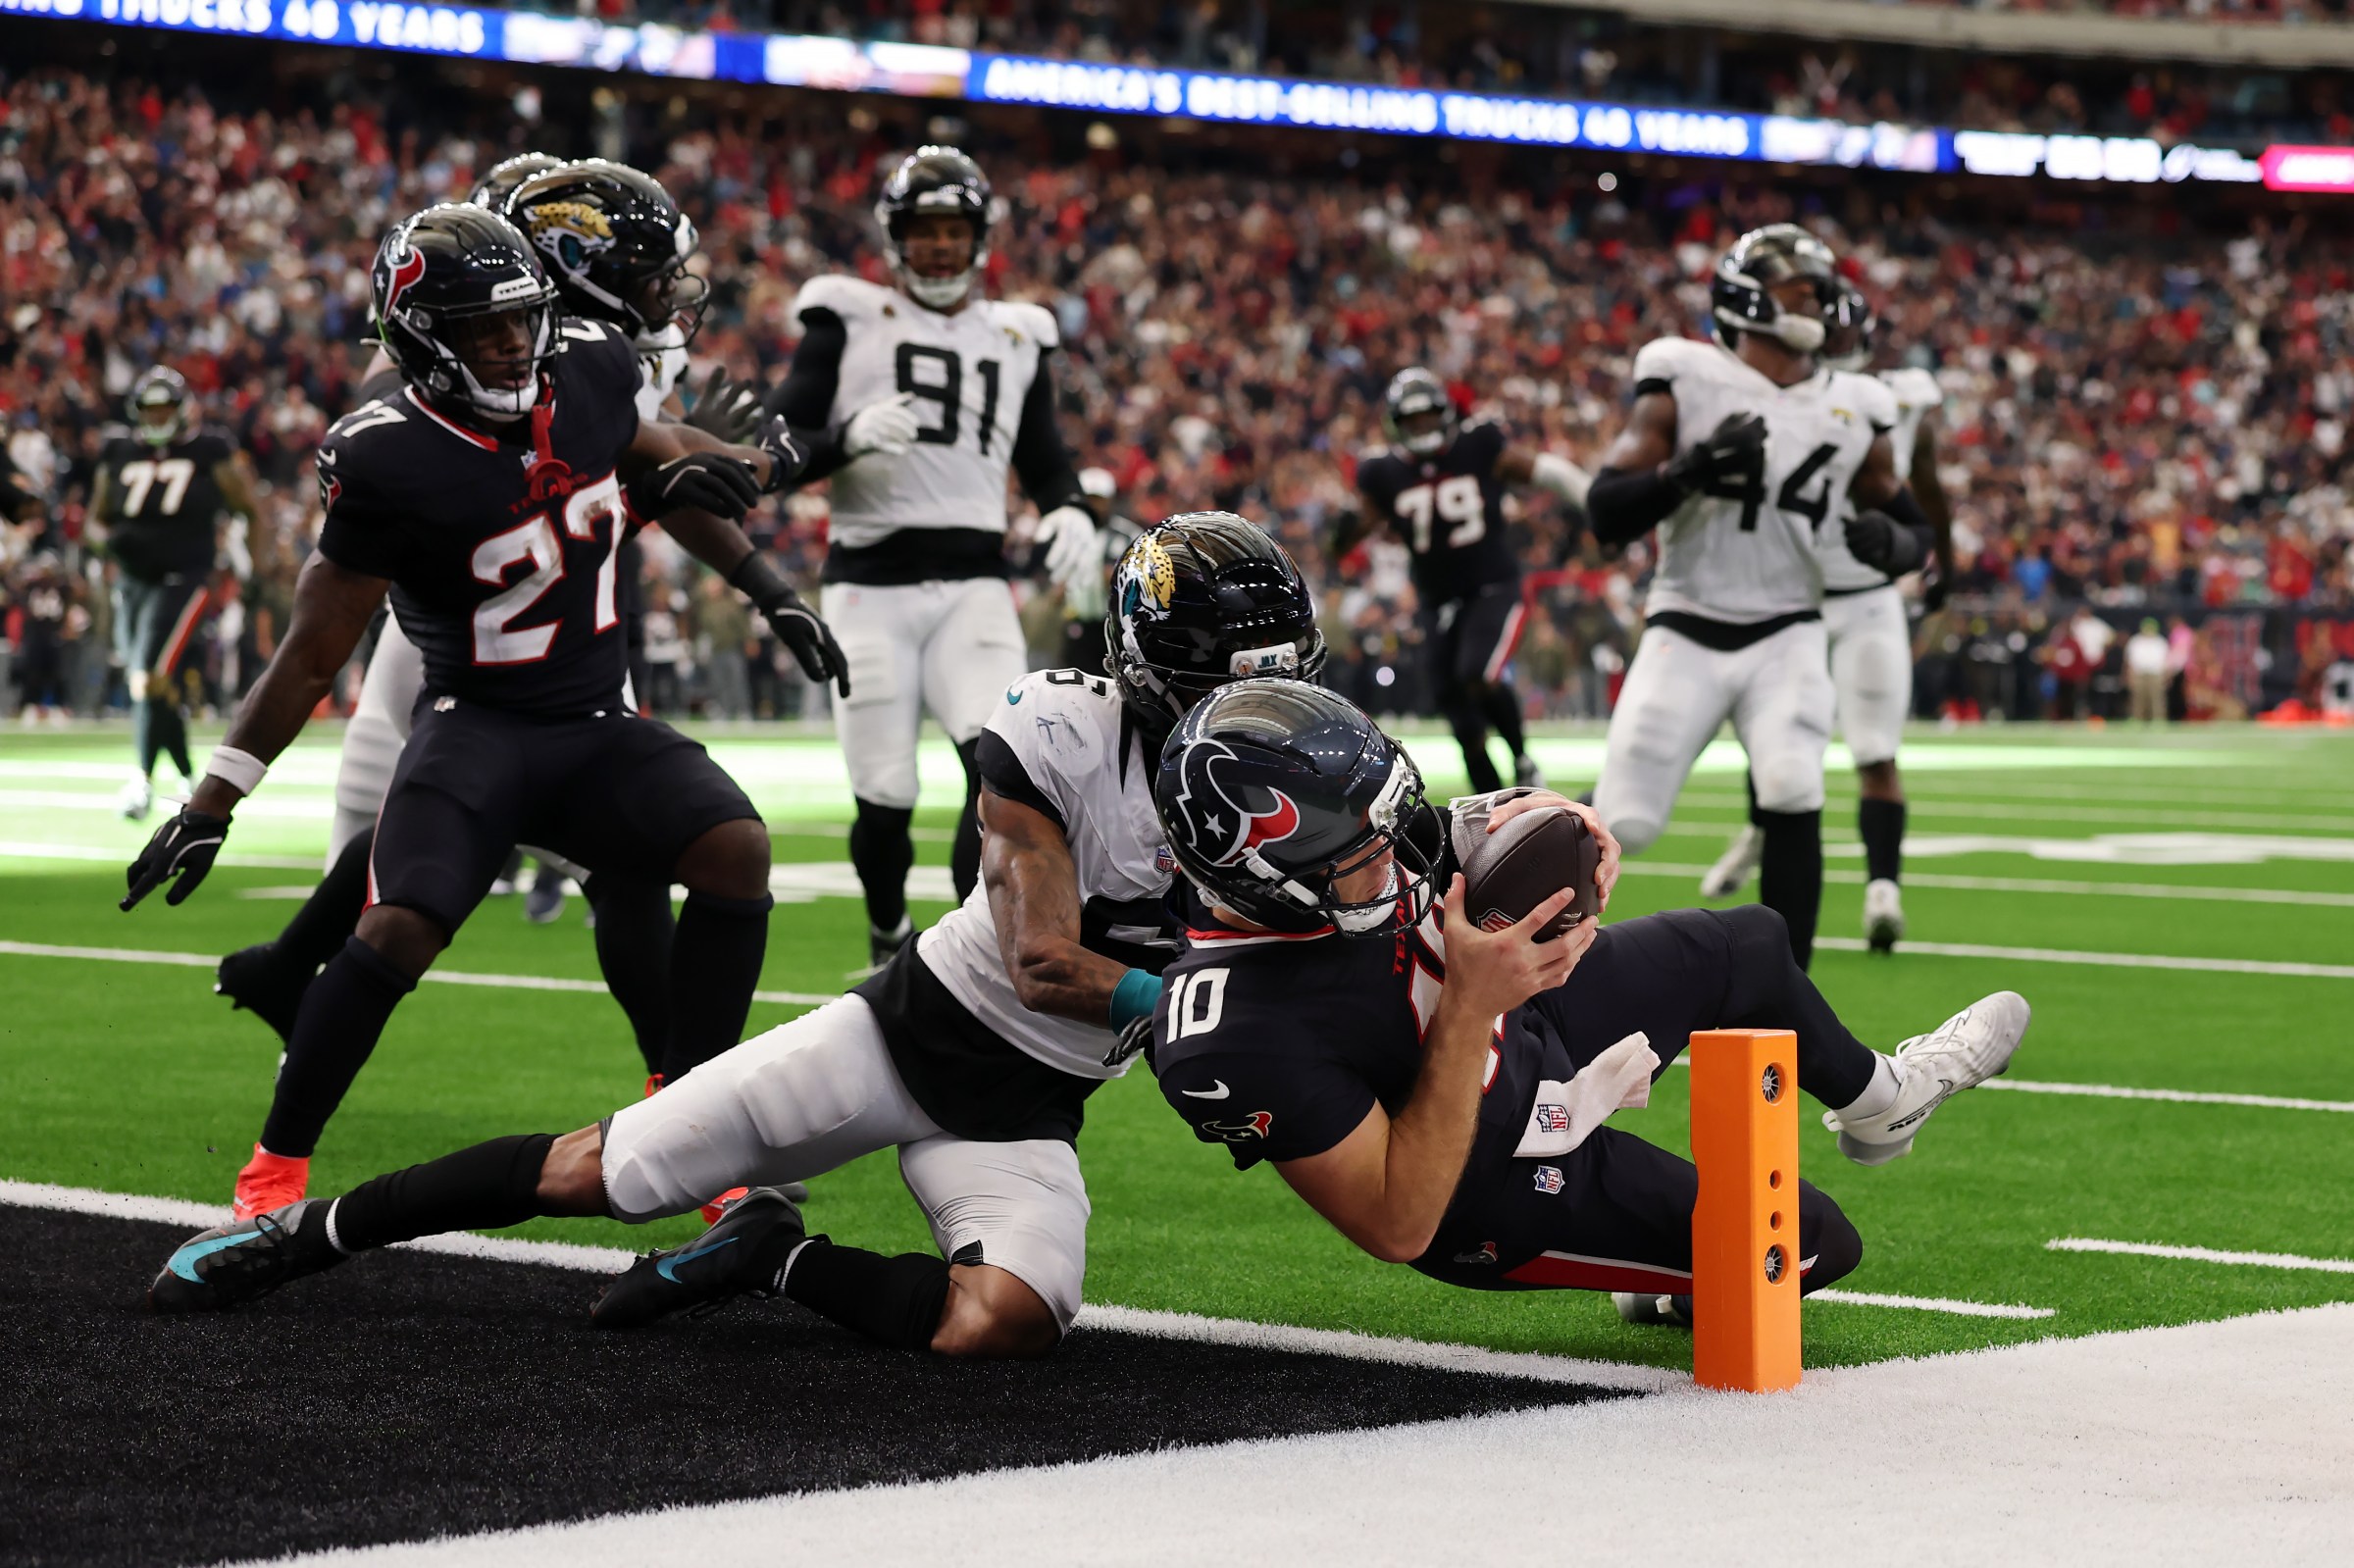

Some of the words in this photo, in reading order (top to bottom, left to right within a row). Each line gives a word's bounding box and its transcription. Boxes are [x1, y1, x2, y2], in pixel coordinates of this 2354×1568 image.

[349, 0, 485, 54] YEARS
[984, 57, 1183, 114] AMERICA'S
[1188, 75, 1437, 133] BEST-SELLING
[1441, 94, 1579, 144] TRUCKS
[1634, 110, 1749, 156] YEARS
[896, 342, 1000, 457] 91
[119, 457, 196, 519] 77
[1394, 473, 1487, 555] 79
[470, 466, 628, 667] 27
[1166, 967, 1231, 1045] 10
[1549, 1107, 1567, 1130] NFL
[1546, 1171, 1561, 1190] NFL
